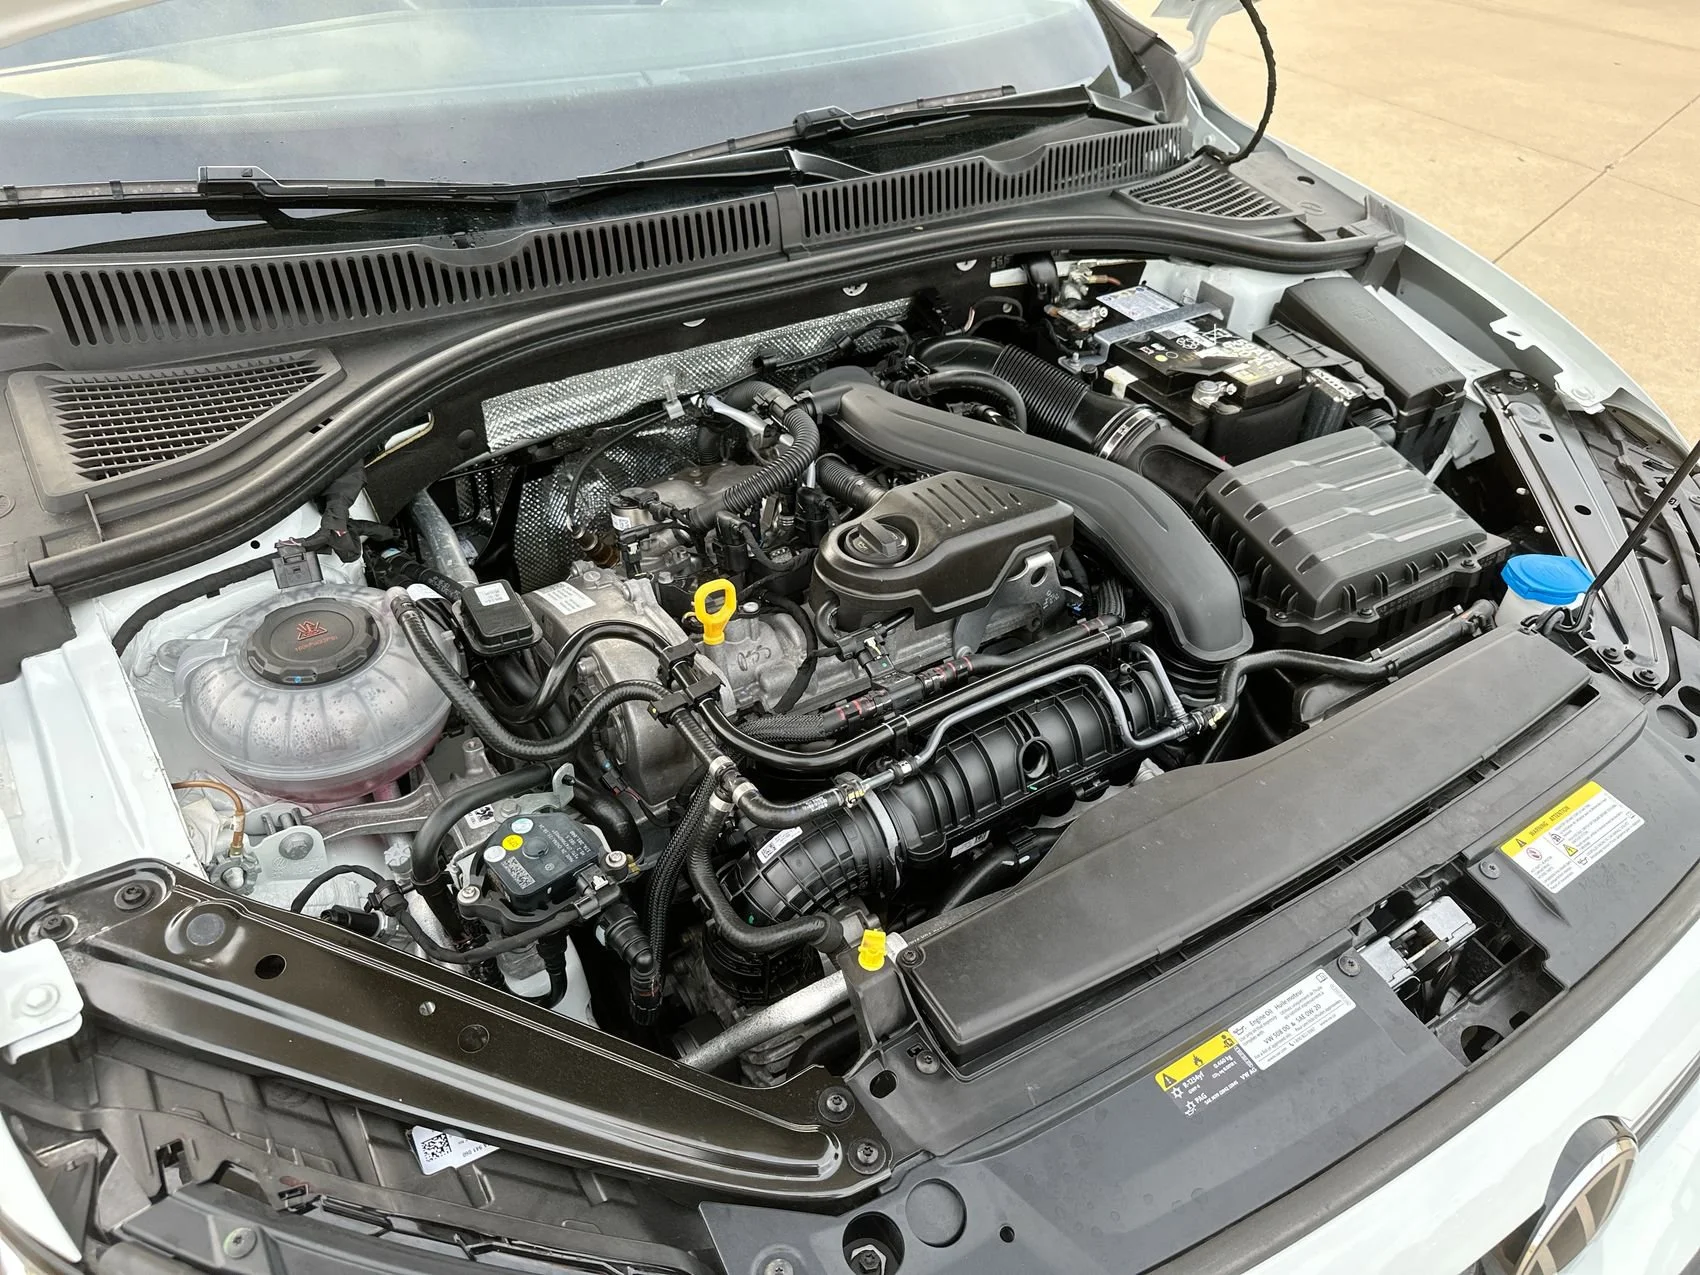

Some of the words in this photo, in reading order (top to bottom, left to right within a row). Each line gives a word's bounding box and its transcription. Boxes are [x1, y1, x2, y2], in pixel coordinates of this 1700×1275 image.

[1549, 806, 1570, 821] ATTENTION
[1249, 1014, 1266, 1027] Engine
[1264, 1008, 1273, 1016] Oil
[1274, 1000, 1287, 1010] Huile
[1286, 989, 1303, 1002] moteur
[1263, 1036, 1274, 1044] VW
[1272, 1029, 1283, 1038] 508
[1281, 1024, 1291, 1032] 00
[1295, 1013, 1306, 1022] SAE
[1304, 1008, 1314, 1017] 0W
[1313, 1003, 1321, 1011] 20
[1182, 1071, 1204, 1088] R-1234yf
[1239, 1071, 1250, 1080] VW
[1249, 1067, 1257, 1075] AG
[1194, 1092, 1207, 1104] PAG
